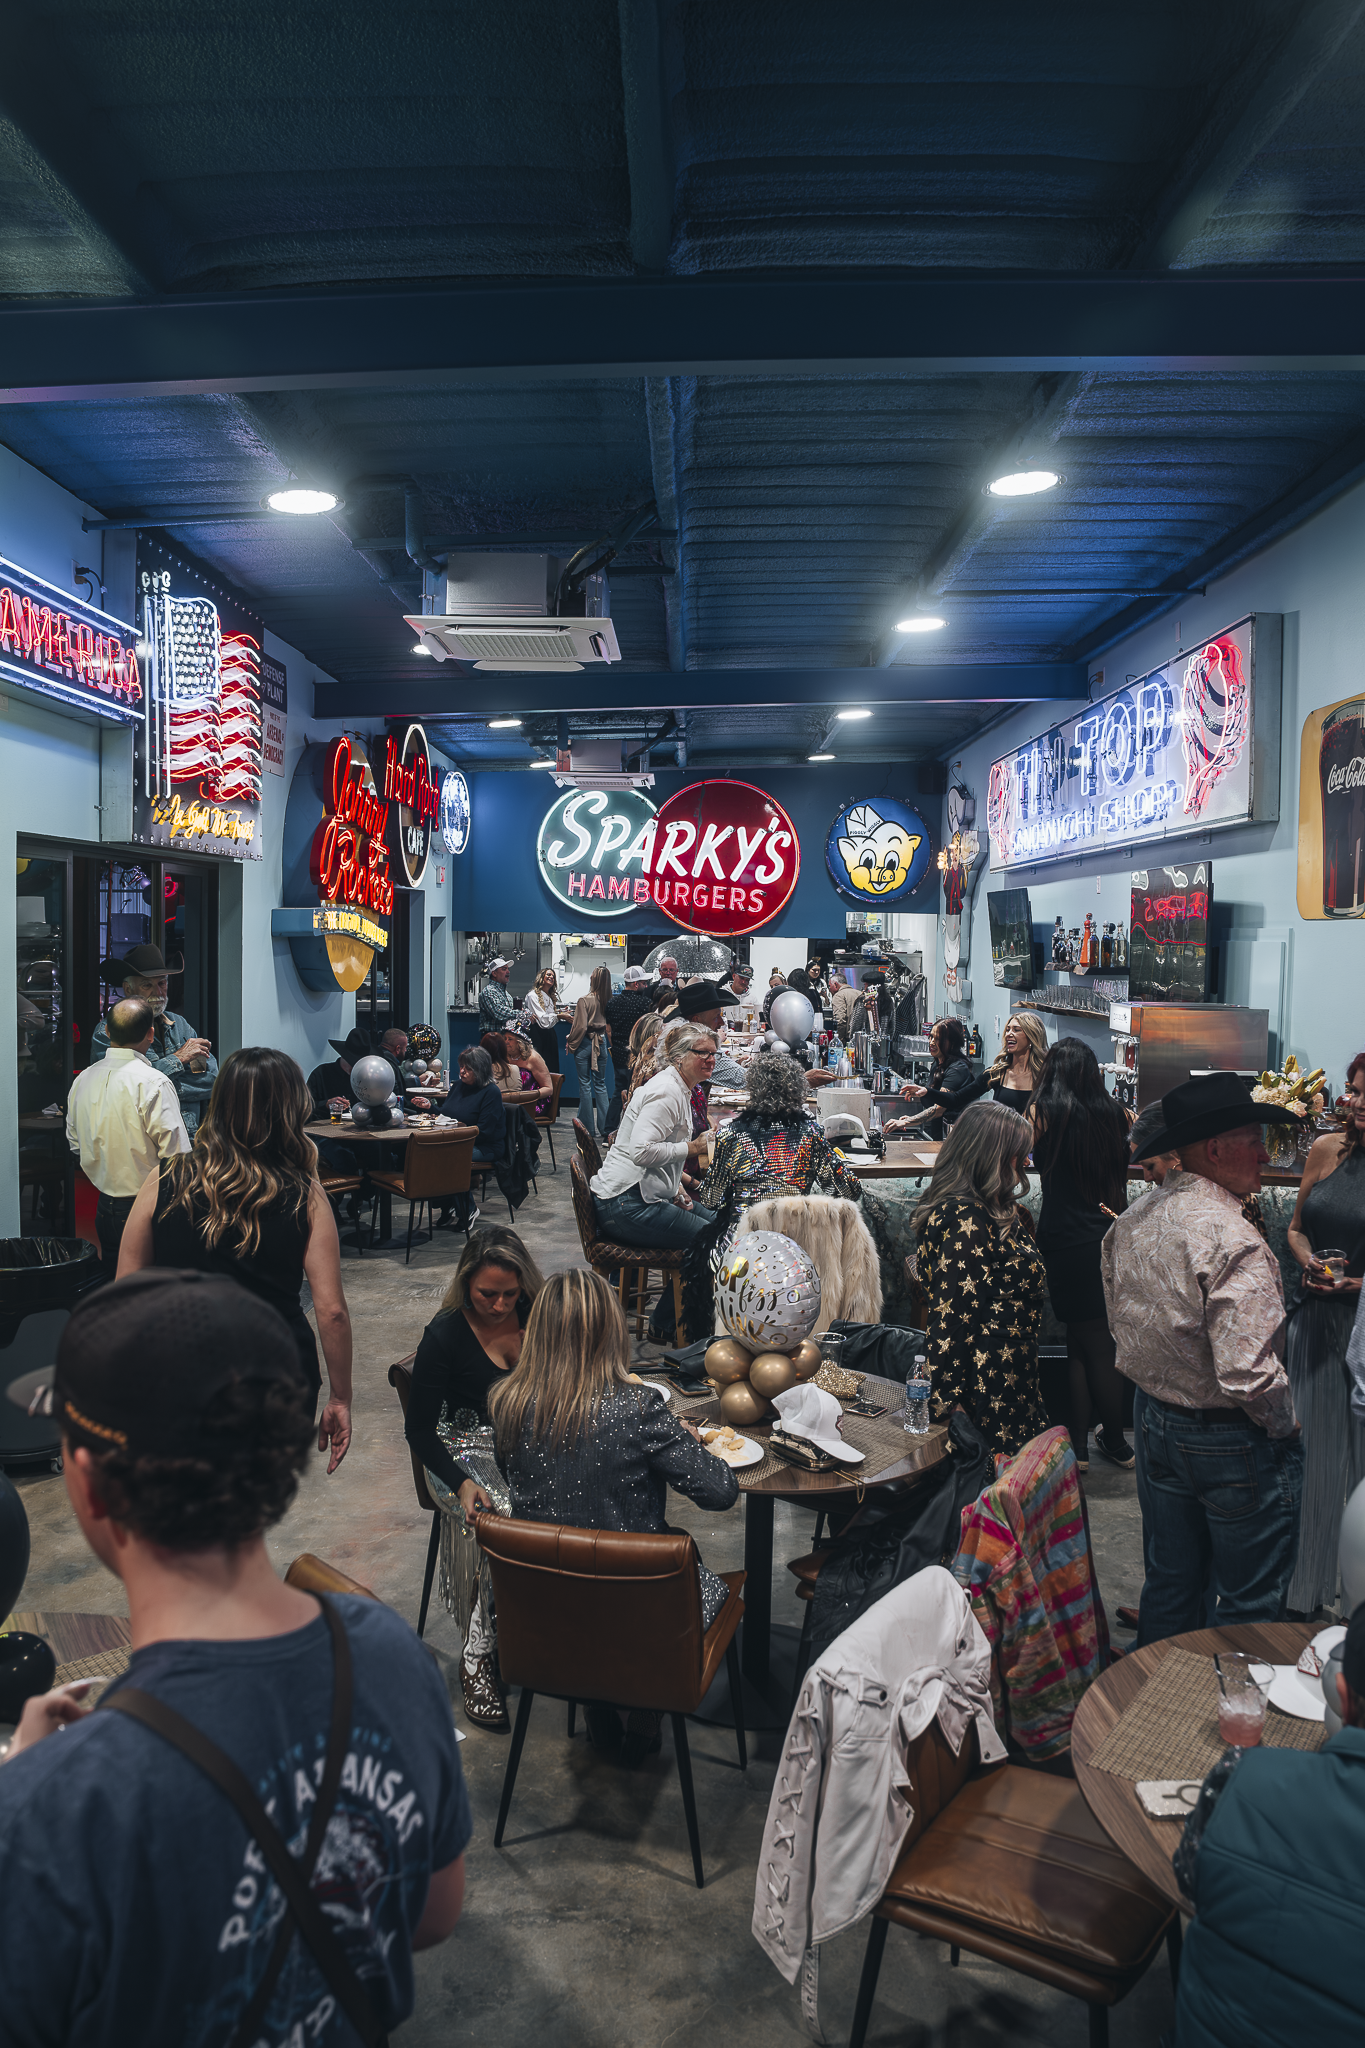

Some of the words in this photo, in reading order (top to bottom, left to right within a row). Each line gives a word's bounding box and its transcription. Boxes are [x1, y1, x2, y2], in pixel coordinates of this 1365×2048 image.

[0, 587, 143, 700] AMERICA
[263, 662, 285, 686] DEFENSE
[267, 685, 284, 704] PLANT
[323, 736, 389, 878] Johnny
[384, 734, 417, 808] Hard
[417, 753, 440, 832] Rock
[211, 807, 228, 836] We
[407, 825, 424, 857] CAFE
[547, 789, 791, 885] SPARKY'S
[1009, 808, 1093, 856] SANDWICH
[1097, 783, 1170, 834] SHOP
[327, 829, 394, 916] Rockets
[567, 871, 766, 914] HAMBURGERS
[738, 1278, 785, 1313] fizz
